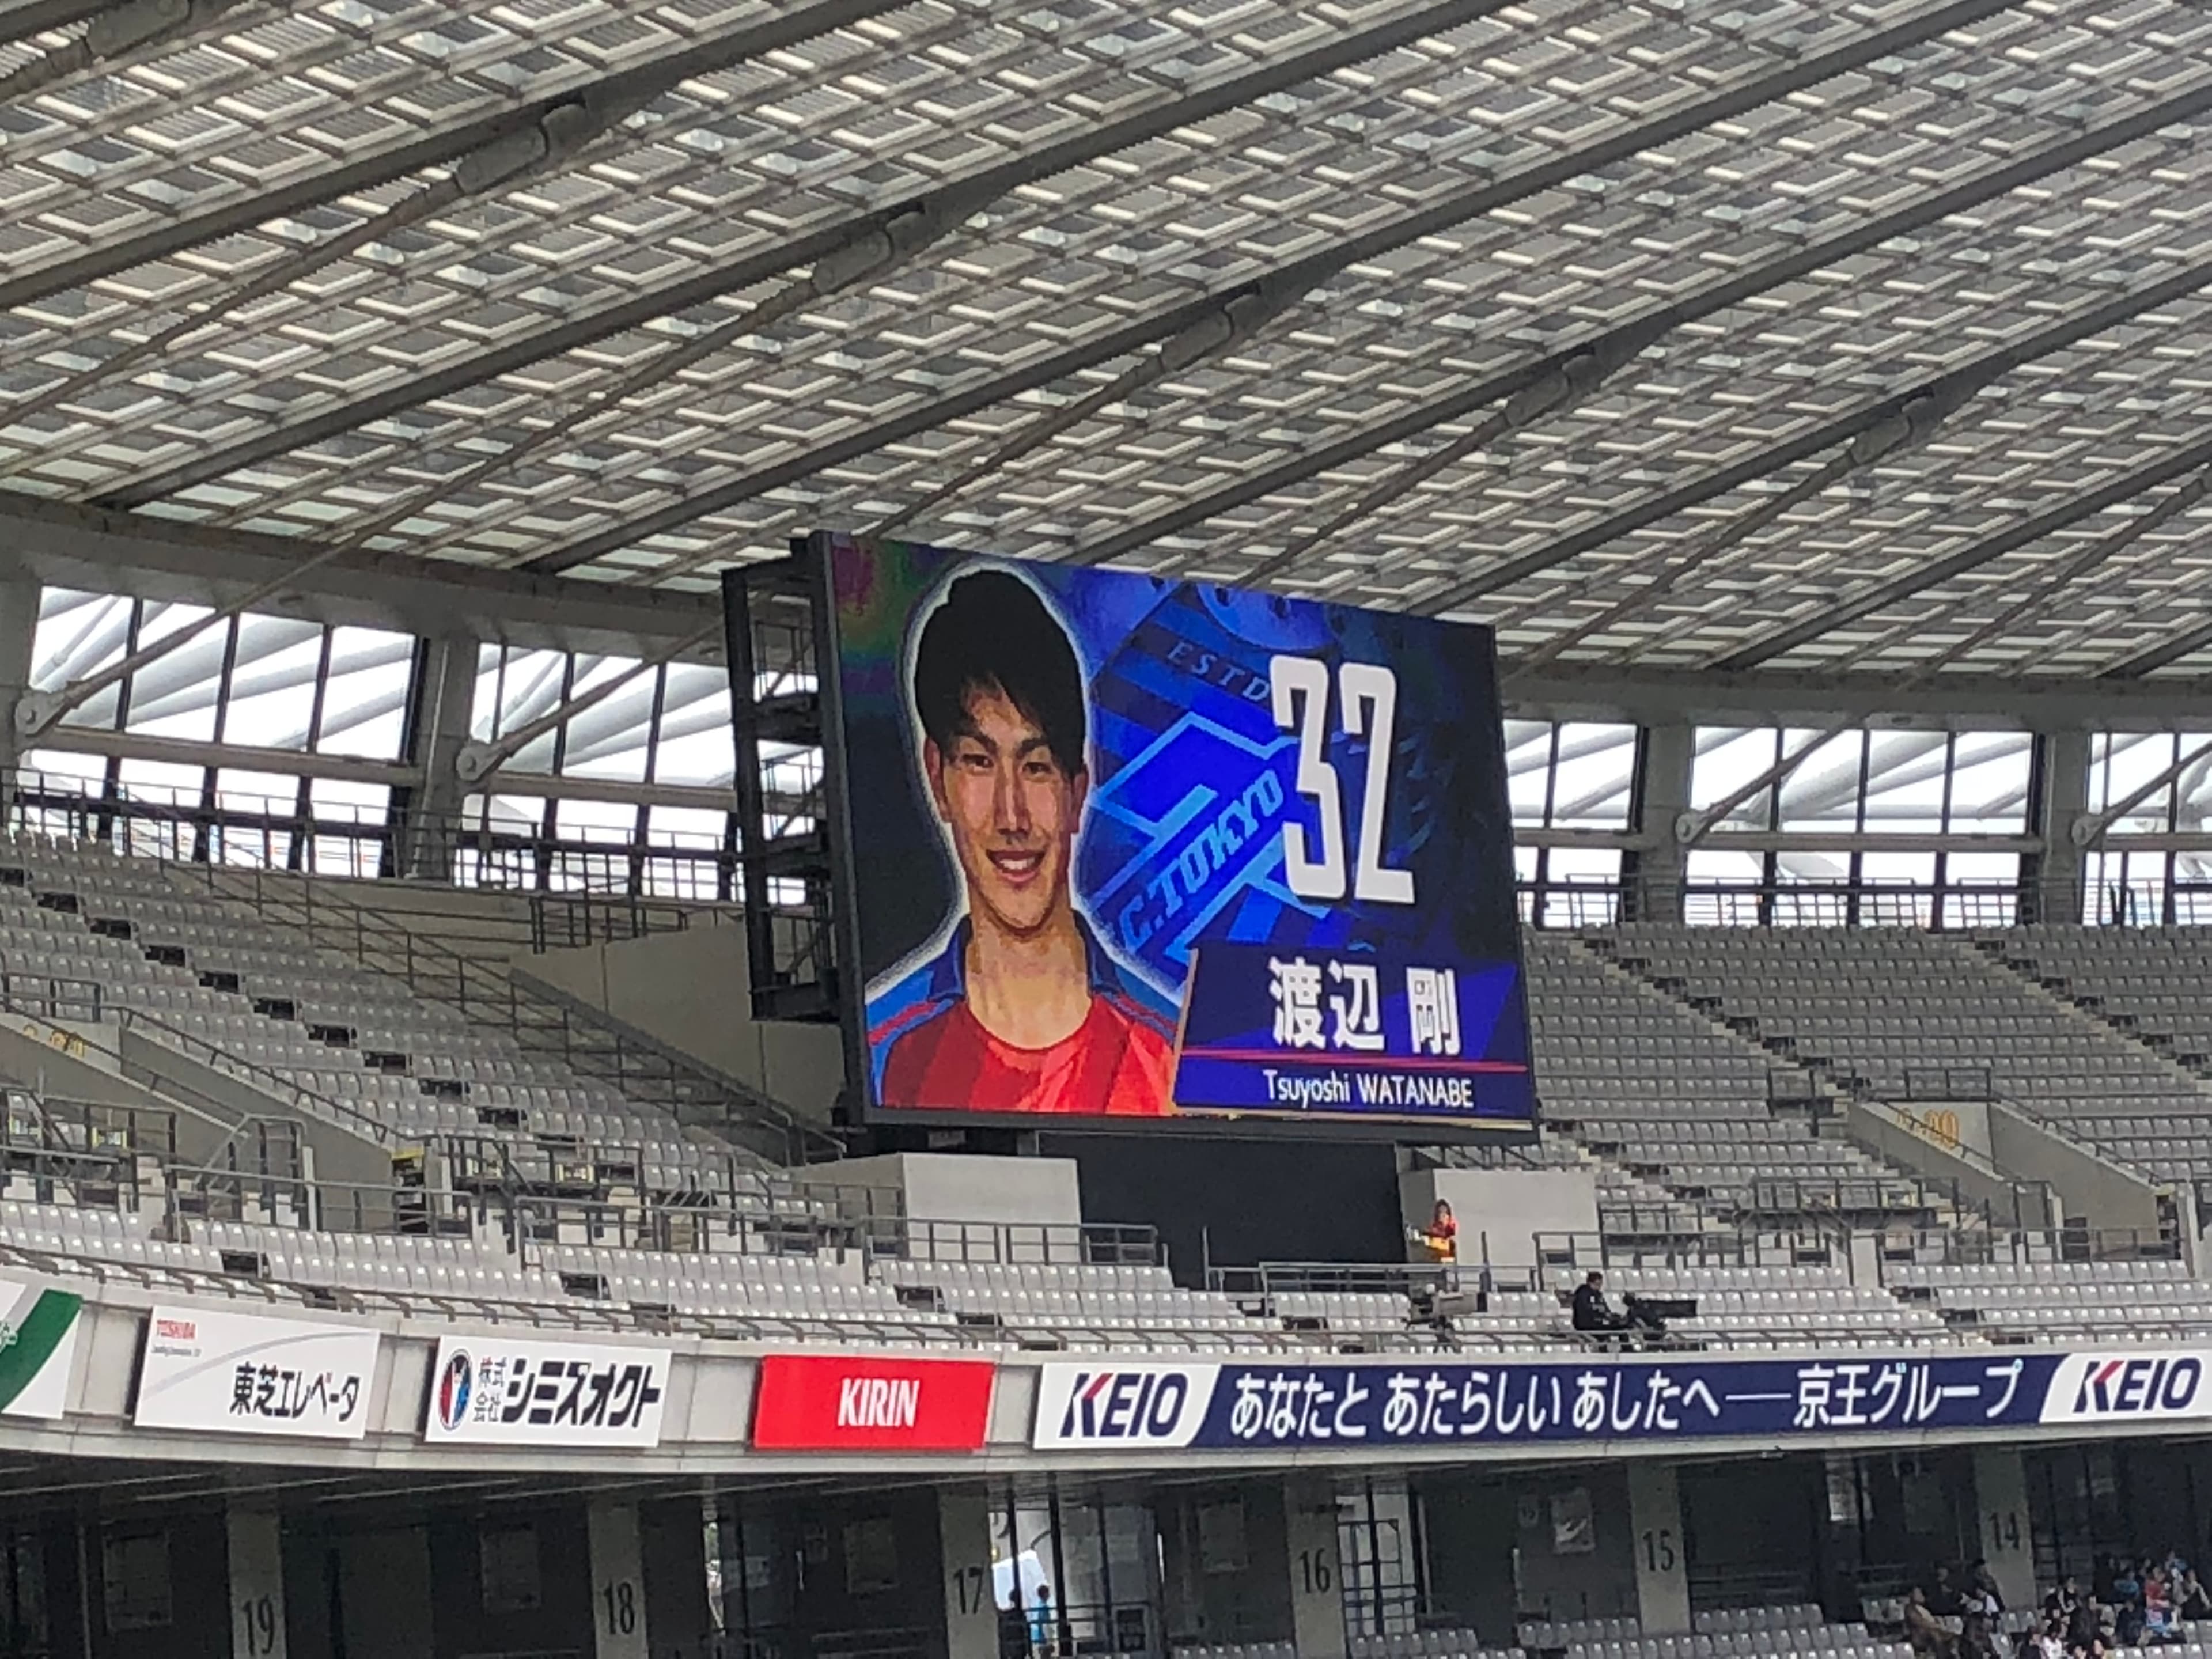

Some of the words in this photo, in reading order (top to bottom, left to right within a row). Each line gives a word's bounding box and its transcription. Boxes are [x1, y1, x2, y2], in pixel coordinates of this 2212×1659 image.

[1166, 641, 1270, 701] ESTD
[1270, 654, 1415, 904] 32
[1268, 956, 1385, 1050] 渡辺
[1406, 967, 1461, 1055] 剛
[1263, 1069, 1350, 1108] Tsuyoshi
[1357, 1073, 1474, 1108] WATANABE
[230, 1361, 361, 1422] 東芝エレベータ
[838, 1378, 921, 1427] KIRIN
[1059, 1373, 1188, 1438] KEIO
[1230, 1372, 1368, 1439] あなたと
[1383, 1371, 1562, 1435] あたらしい
[2073, 1358, 2202, 1412] KEIO
[1642, 1529, 1675, 1573] 15
[1989, 1512, 2021, 1551] 14
[953, 1567, 982, 1615] 17
[1299, 1548, 1331, 1593] 16
[241, 1598, 275, 1657] 19
[603, 1581, 635, 1635] 18
